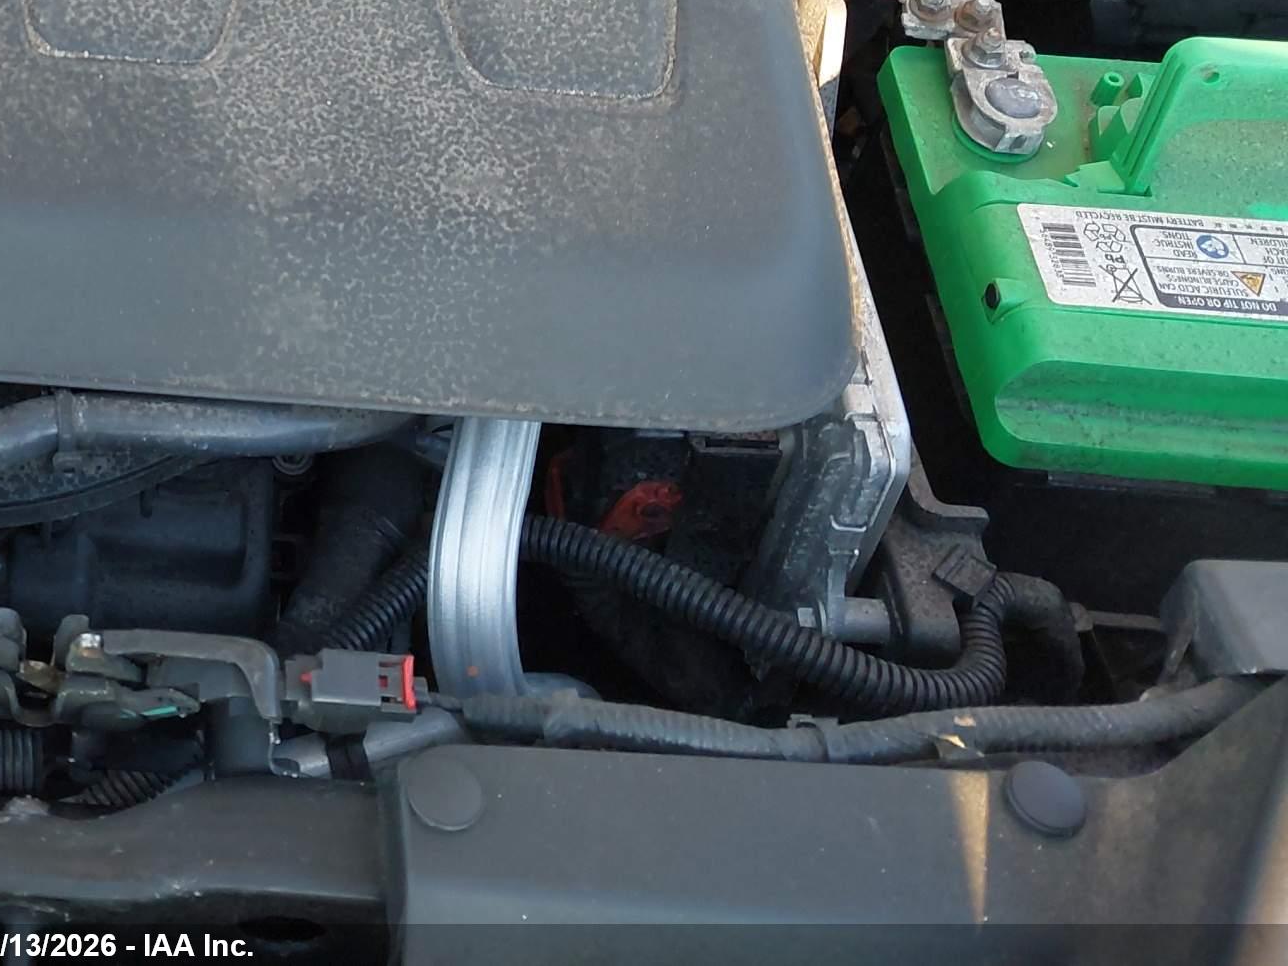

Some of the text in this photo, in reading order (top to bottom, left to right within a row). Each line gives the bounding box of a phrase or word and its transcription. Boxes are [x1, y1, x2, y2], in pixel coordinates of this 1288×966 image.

[1123, 214, 1135, 222] BE
[1139, 215, 1163, 224] MUST
[1166, 217, 1204, 226] BATTERY
[1104, 254, 1126, 264] Pb
[1173, 249, 1198, 259] READ
[1159, 283, 1249, 297] SULFURIC ACID CAN
[1174, 296, 1278, 312] DO NOT TIP OR OPEN.
